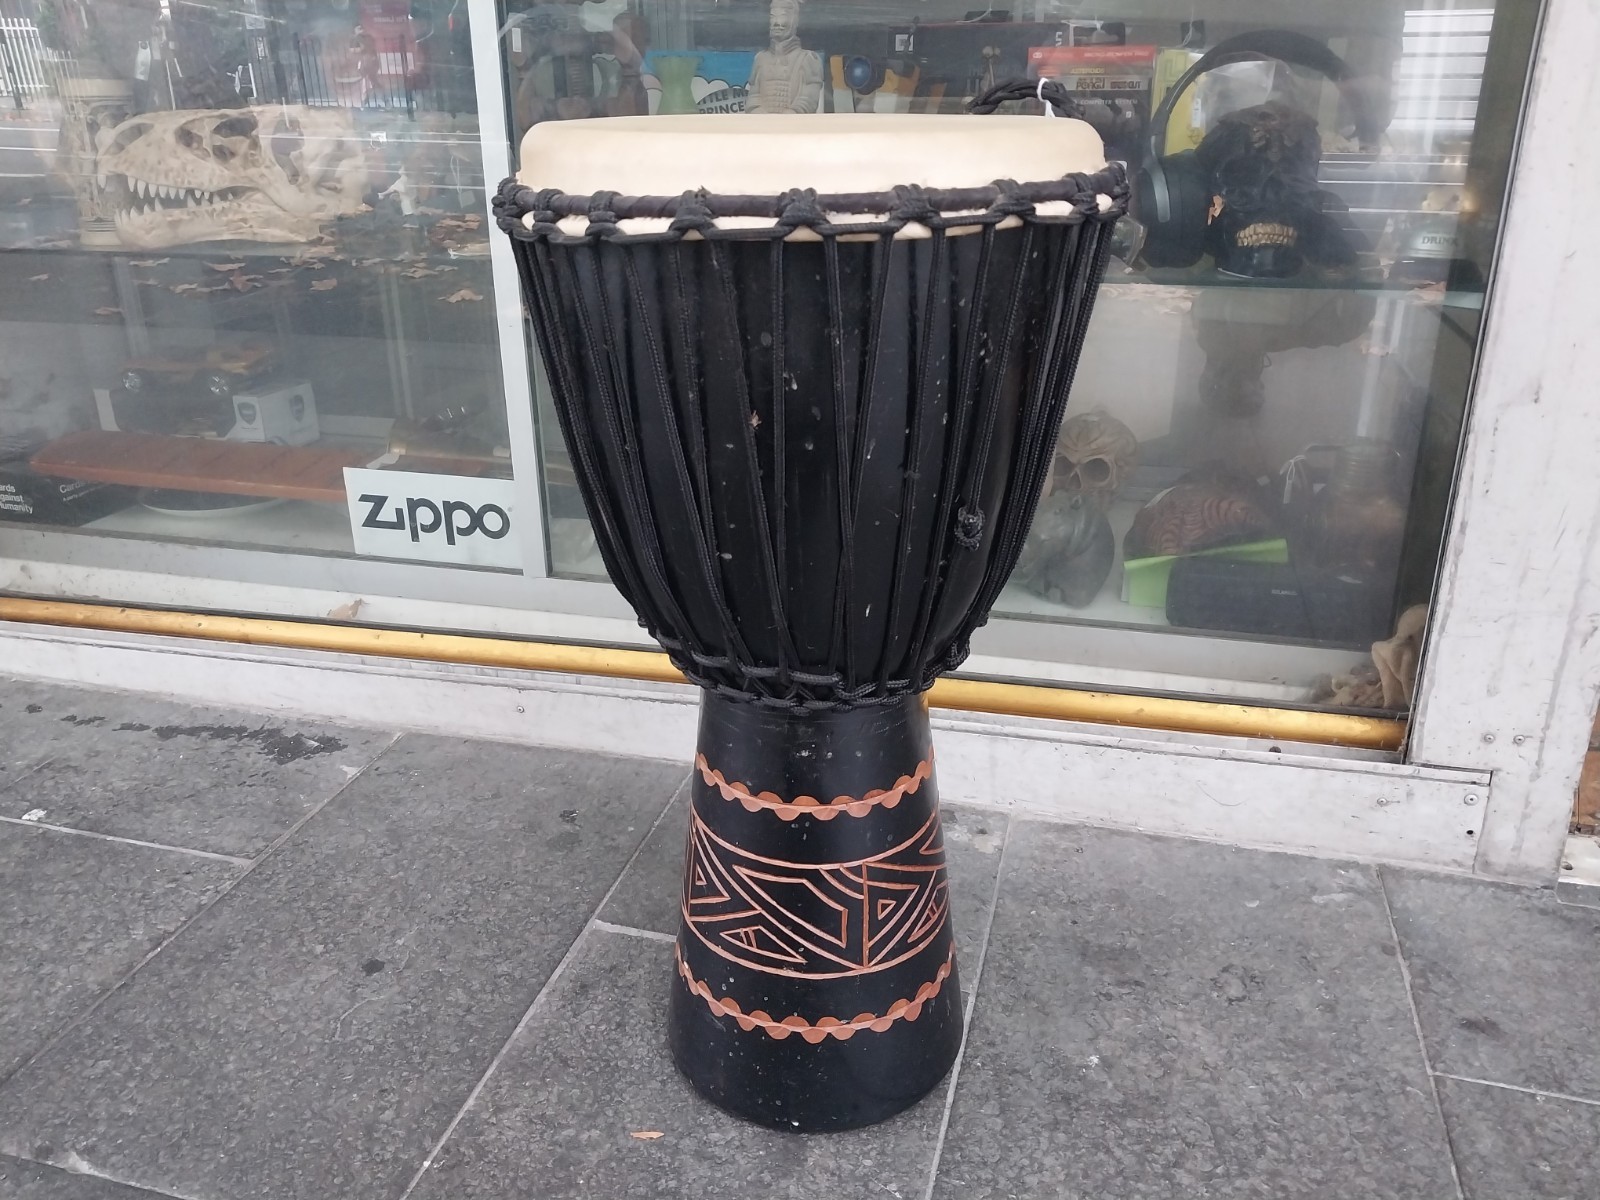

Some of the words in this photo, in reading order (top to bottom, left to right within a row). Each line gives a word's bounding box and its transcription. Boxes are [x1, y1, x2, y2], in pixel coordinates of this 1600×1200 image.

[0, 484, 15, 493] ards
[60, 481, 86, 493] Card
[0, 493, 24, 502] gainst
[358, 494, 510, 546] Zippo
